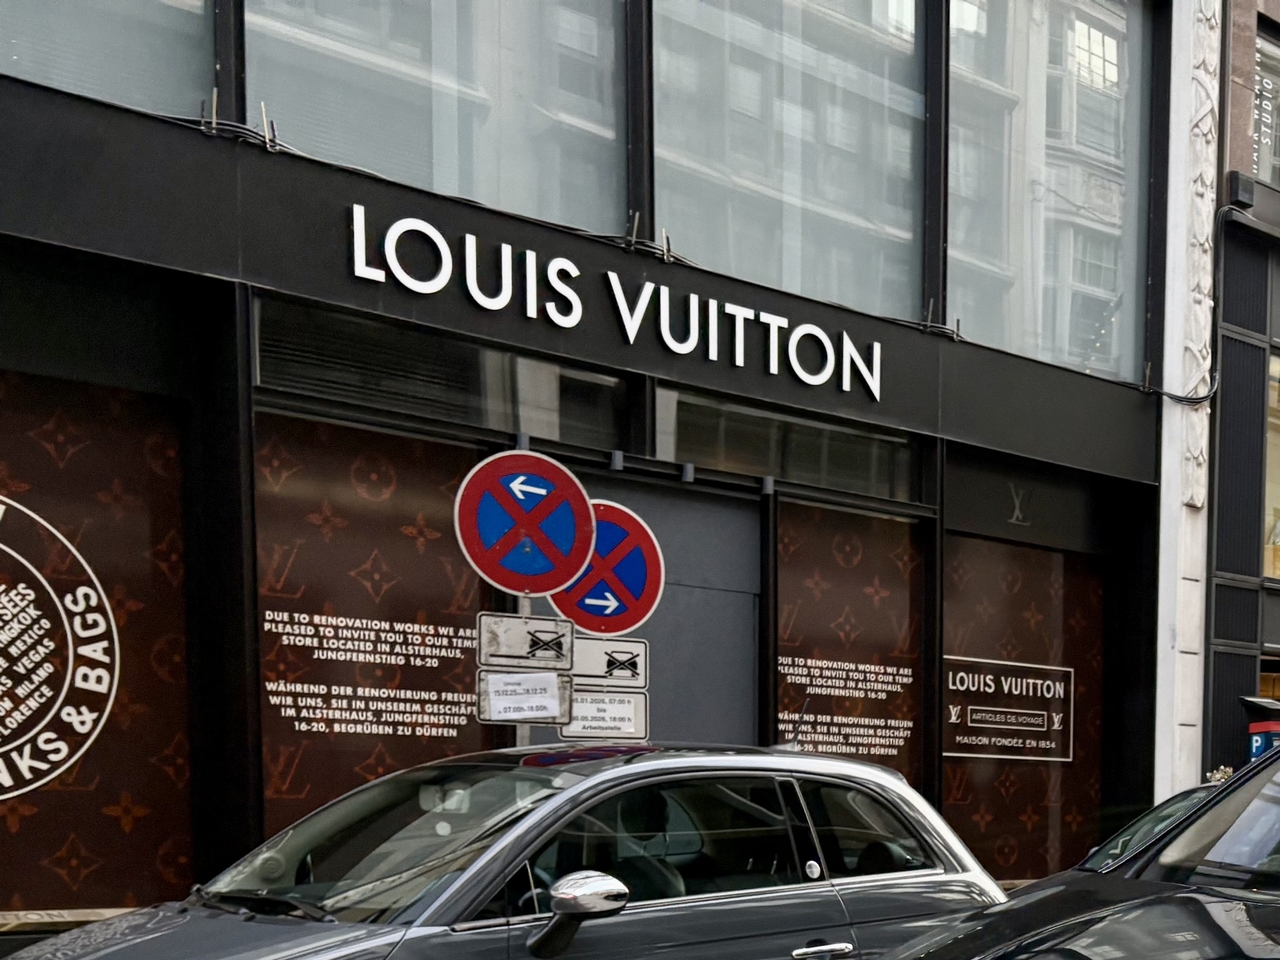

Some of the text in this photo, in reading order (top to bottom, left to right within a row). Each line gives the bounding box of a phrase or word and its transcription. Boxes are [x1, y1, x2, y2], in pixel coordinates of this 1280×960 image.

[1261, 78, 1273, 146] STUDIO
[352, 203, 881, 402] LOUIS VUITTON
[0, 603, 43, 648] NGKOK
[265, 611, 477, 638] DUE TO RENOVATION WORKS WE ARE
[7, 618, 51, 657] MEXICO
[64, 586, 111, 694] BAGS
[264, 623, 315, 636] PLEASED
[318, 626, 334, 637] TO
[338, 629, 376, 641] INVITE
[380, 632, 401, 643] YOU
[407, 634, 422, 645] TO
[425, 636, 449, 647] OUR
[12, 638, 55, 674] VEGAS
[282, 635, 465, 659] STORE LOCATED IN ALSTERHAUS,
[312, 649, 439, 667] JUNGFERNSTIEG 16-20
[794, 658, 805, 667] TO
[806, 659, 856, 671] RENOVATION
[857, 663, 885, 674] WORKS
[886, 666, 897, 675] WE
[899, 667, 912, 676] ARE
[15, 662, 55, 698] MILANO
[786, 675, 904, 693] STORE LOCATED IN ALSTERHAUS,
[810, 668, 820, 677] TO
[822, 669, 847, 679] INVITE
[848, 672, 865, 681] YOU
[866, 673, 877, 682] TO
[878, 674, 893, 683] OUR
[894, 676, 913, 684] TEMP
[948, 671, 1064, 699] LOUIS VUITTON
[265, 681, 328, 694] WÄHREND
[331, 686, 353, 697] DER
[357, 688, 438, 701] RENOVIERUNG
[805, 686, 887, 700] JUNGFERNSTIEG 16-20
[0, 684, 54, 736] LORENCE
[269, 696, 477, 715] WIR UNS, SIE IN UNSEREM GESCHÄFT
[60, 705, 99, 734] &
[281, 708, 468, 725] IM ALSTERHAUS, JUNGFERNSTIEG
[778, 710, 913, 728] WÄHRND DER RENOVIERUNG FREUEN
[972, 713, 1005, 723] ARTICLES
[1007, 715, 1017, 723] DE
[1017, 716, 1044, 725] VOYAGE
[294, 721, 329, 734] 16-20,
[396, 726, 412, 736] ZU
[416, 725, 458, 737] DÜRFEN
[816, 725, 828, 733] SIE
[830, 725, 839, 733] IN
[840, 726, 875, 736] UNSEREM
[876, 727, 911, 738] GESCHÄFT
[797, 733, 845, 744] ALSTERHAUS,
[848, 735, 905, 746] JUNGFERNSTIEG
[956, 735, 989, 745] MAISON
[991, 736, 1024, 747] FONDÉE
[1025, 739, 1036, 748] EN
[1252, 736, 1261, 753] P
[858, 746, 869, 755] ZU
[870, 745, 898, 756] DÜRFEN
